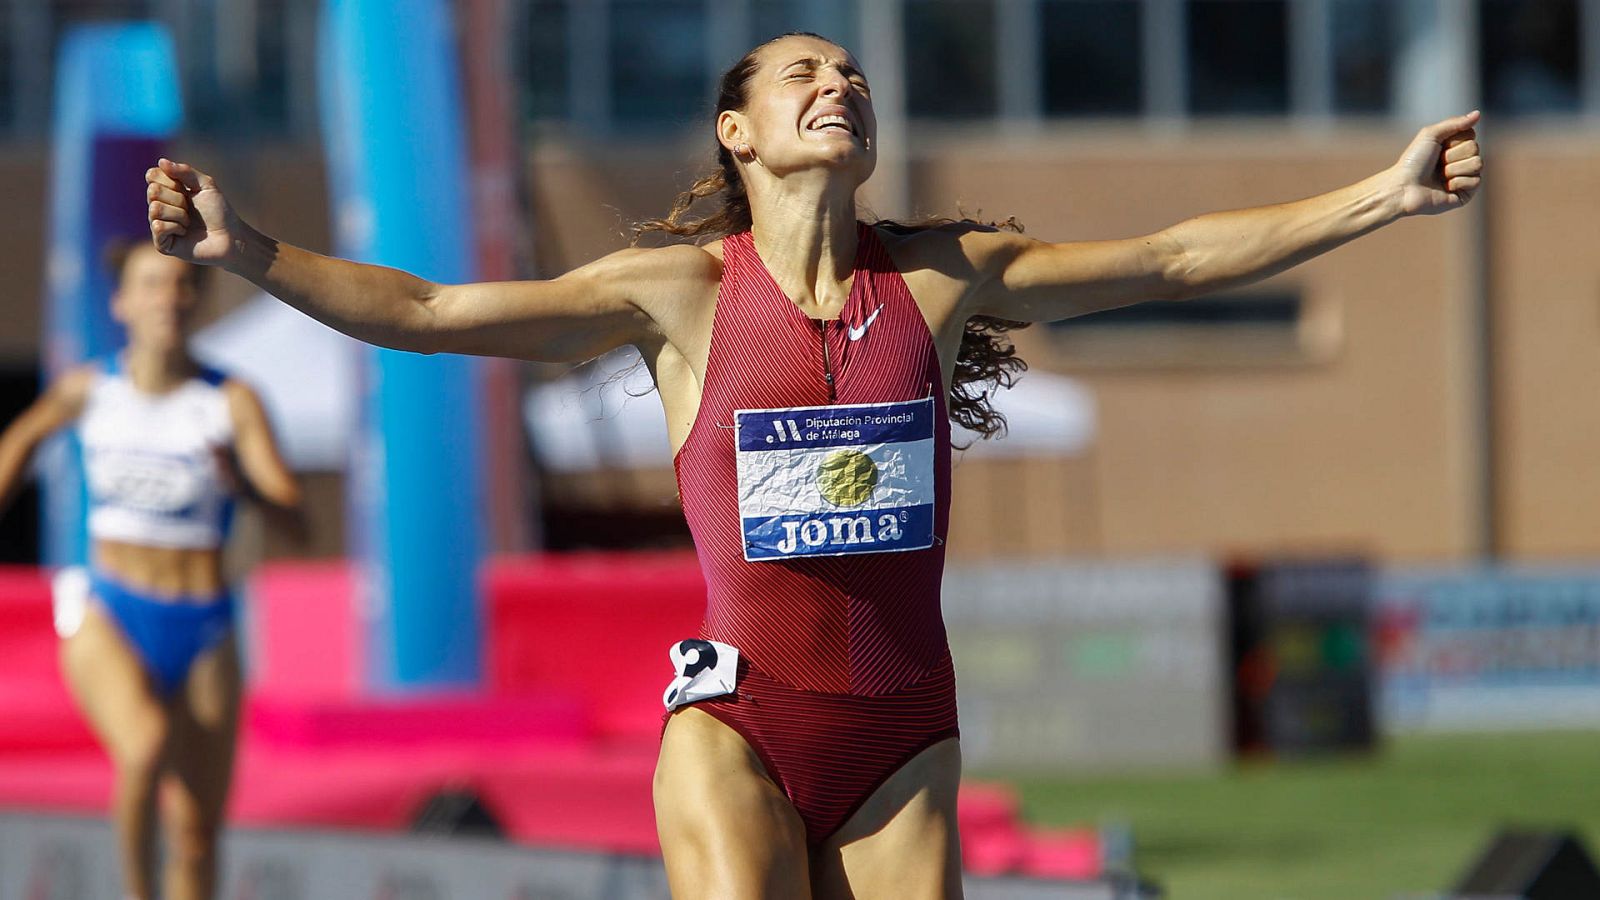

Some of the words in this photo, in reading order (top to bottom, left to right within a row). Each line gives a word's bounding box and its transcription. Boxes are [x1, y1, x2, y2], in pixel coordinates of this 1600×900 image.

[805, 415, 861, 429] Diputación
[864, 412, 914, 425] Provincial
[806, 432, 819, 441] de
[822, 429, 860, 441] Málaga
